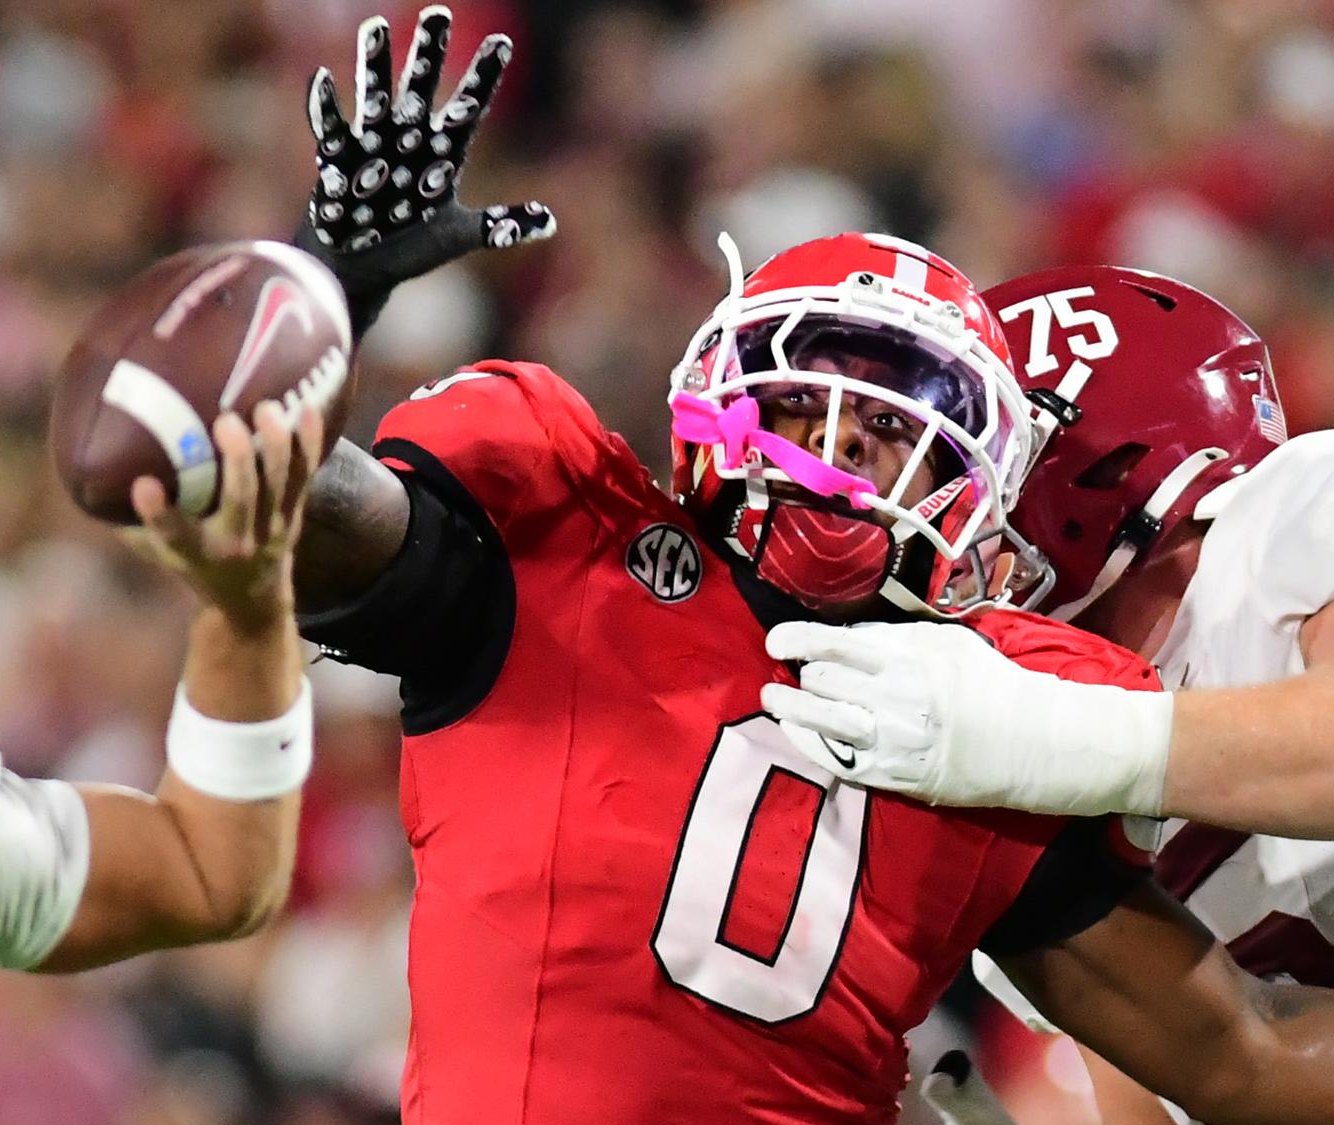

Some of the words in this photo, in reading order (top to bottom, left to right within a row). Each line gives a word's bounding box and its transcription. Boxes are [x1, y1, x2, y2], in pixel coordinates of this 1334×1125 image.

[998, 286, 1119, 378] 75
[632, 528, 697, 597] SEC
[650, 711, 869, 1024] 0
